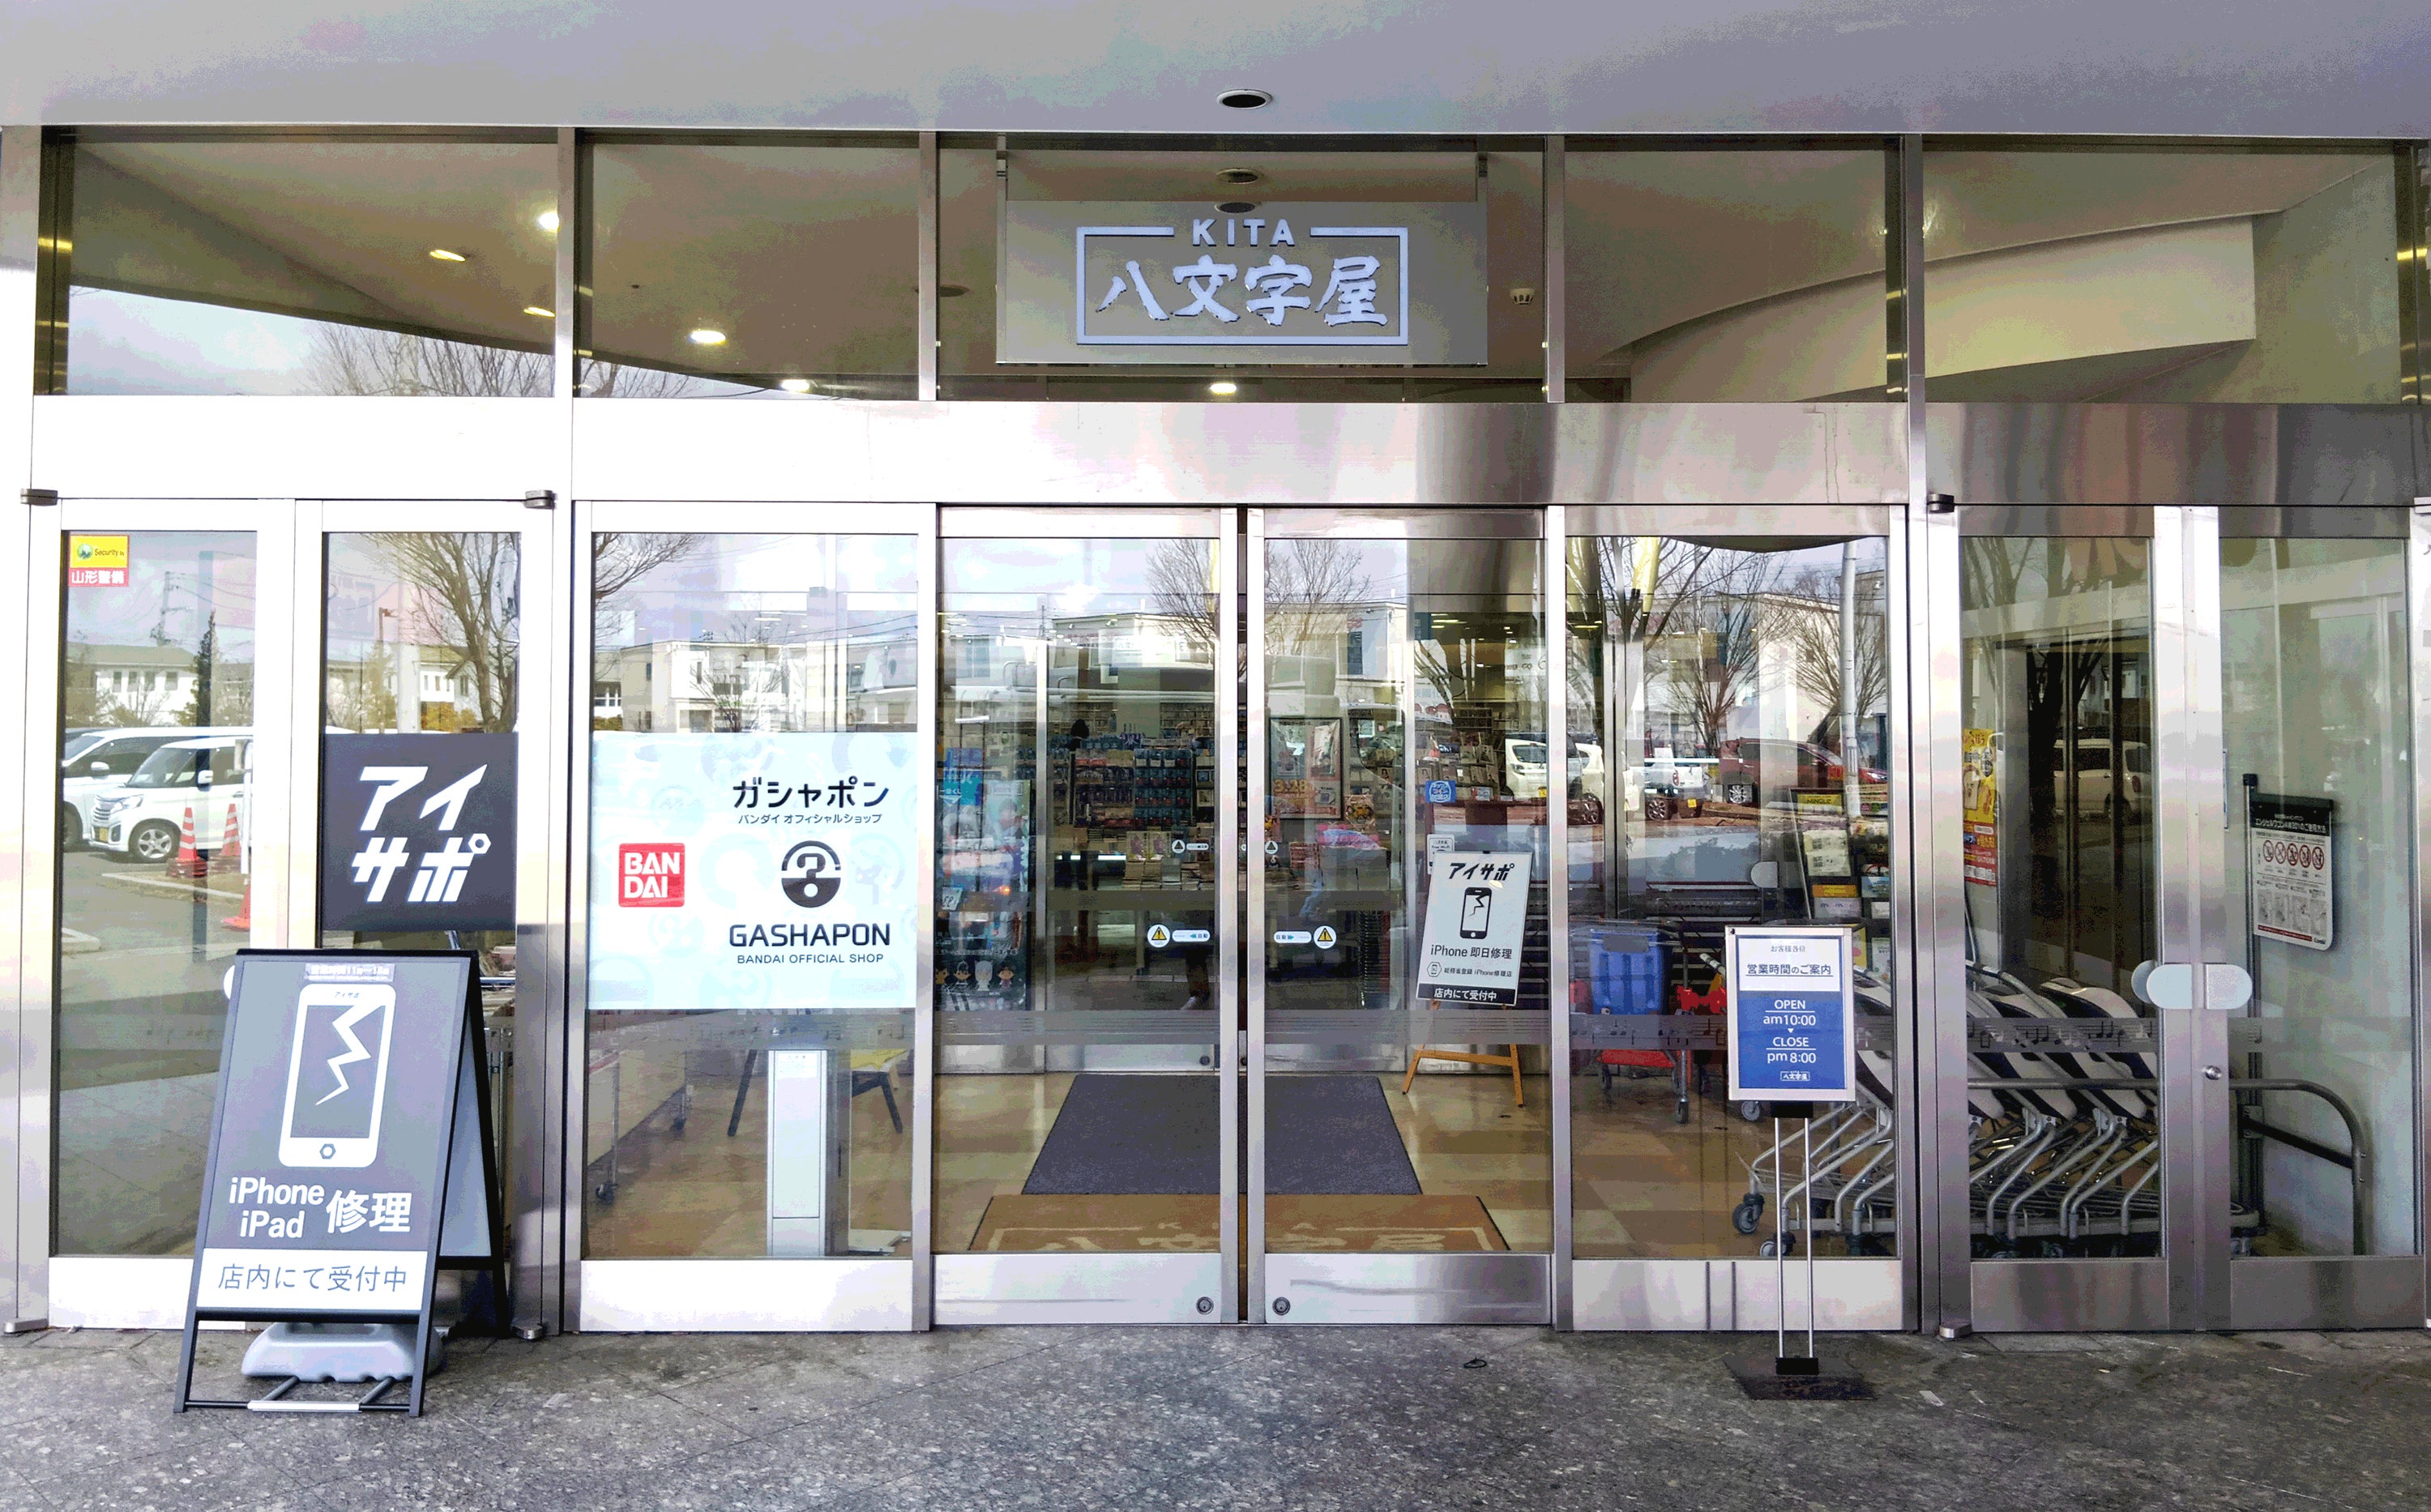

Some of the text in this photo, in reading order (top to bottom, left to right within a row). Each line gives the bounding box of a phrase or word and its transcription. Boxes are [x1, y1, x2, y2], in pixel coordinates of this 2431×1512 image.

[1192, 218, 1295, 246] KITA
[1095, 253, 1388, 327] 八文字屋
[94, 548, 118, 557] Security
[71, 570, 126, 584] 山形警備
[733, 775, 890, 809] ガシャポン
[738, 814, 882, 824] バンダイ オフィシャルショップ
[624, 852, 681, 875] BAN
[1447, 861, 1516, 882] アイサポ
[624, 876, 669, 899] DAI
[729, 923, 891, 947] GASHAPON
[1430, 944, 1512, 959] iPhone 即日修理
[1771, 945, 1806, 953] お客様各位
[737, 955, 884, 964] BANDAI OFFICIAL SHOP
[1746, 963, 1831, 976] 営業時間のご案内
[1433, 987, 1497, 1002] 店内にて受付中
[1774, 999, 1805, 1010] OPEN
[1772, 1036, 1809, 1047] CLOSE
[1767, 1052, 1816, 1064] pm 8:00
[229, 1177, 325, 1206] iPhone
[326, 1190, 412, 1234] 修理
[240, 1210, 304, 1239] iPad
[217, 1262, 408, 1293] 店内にて受付中
